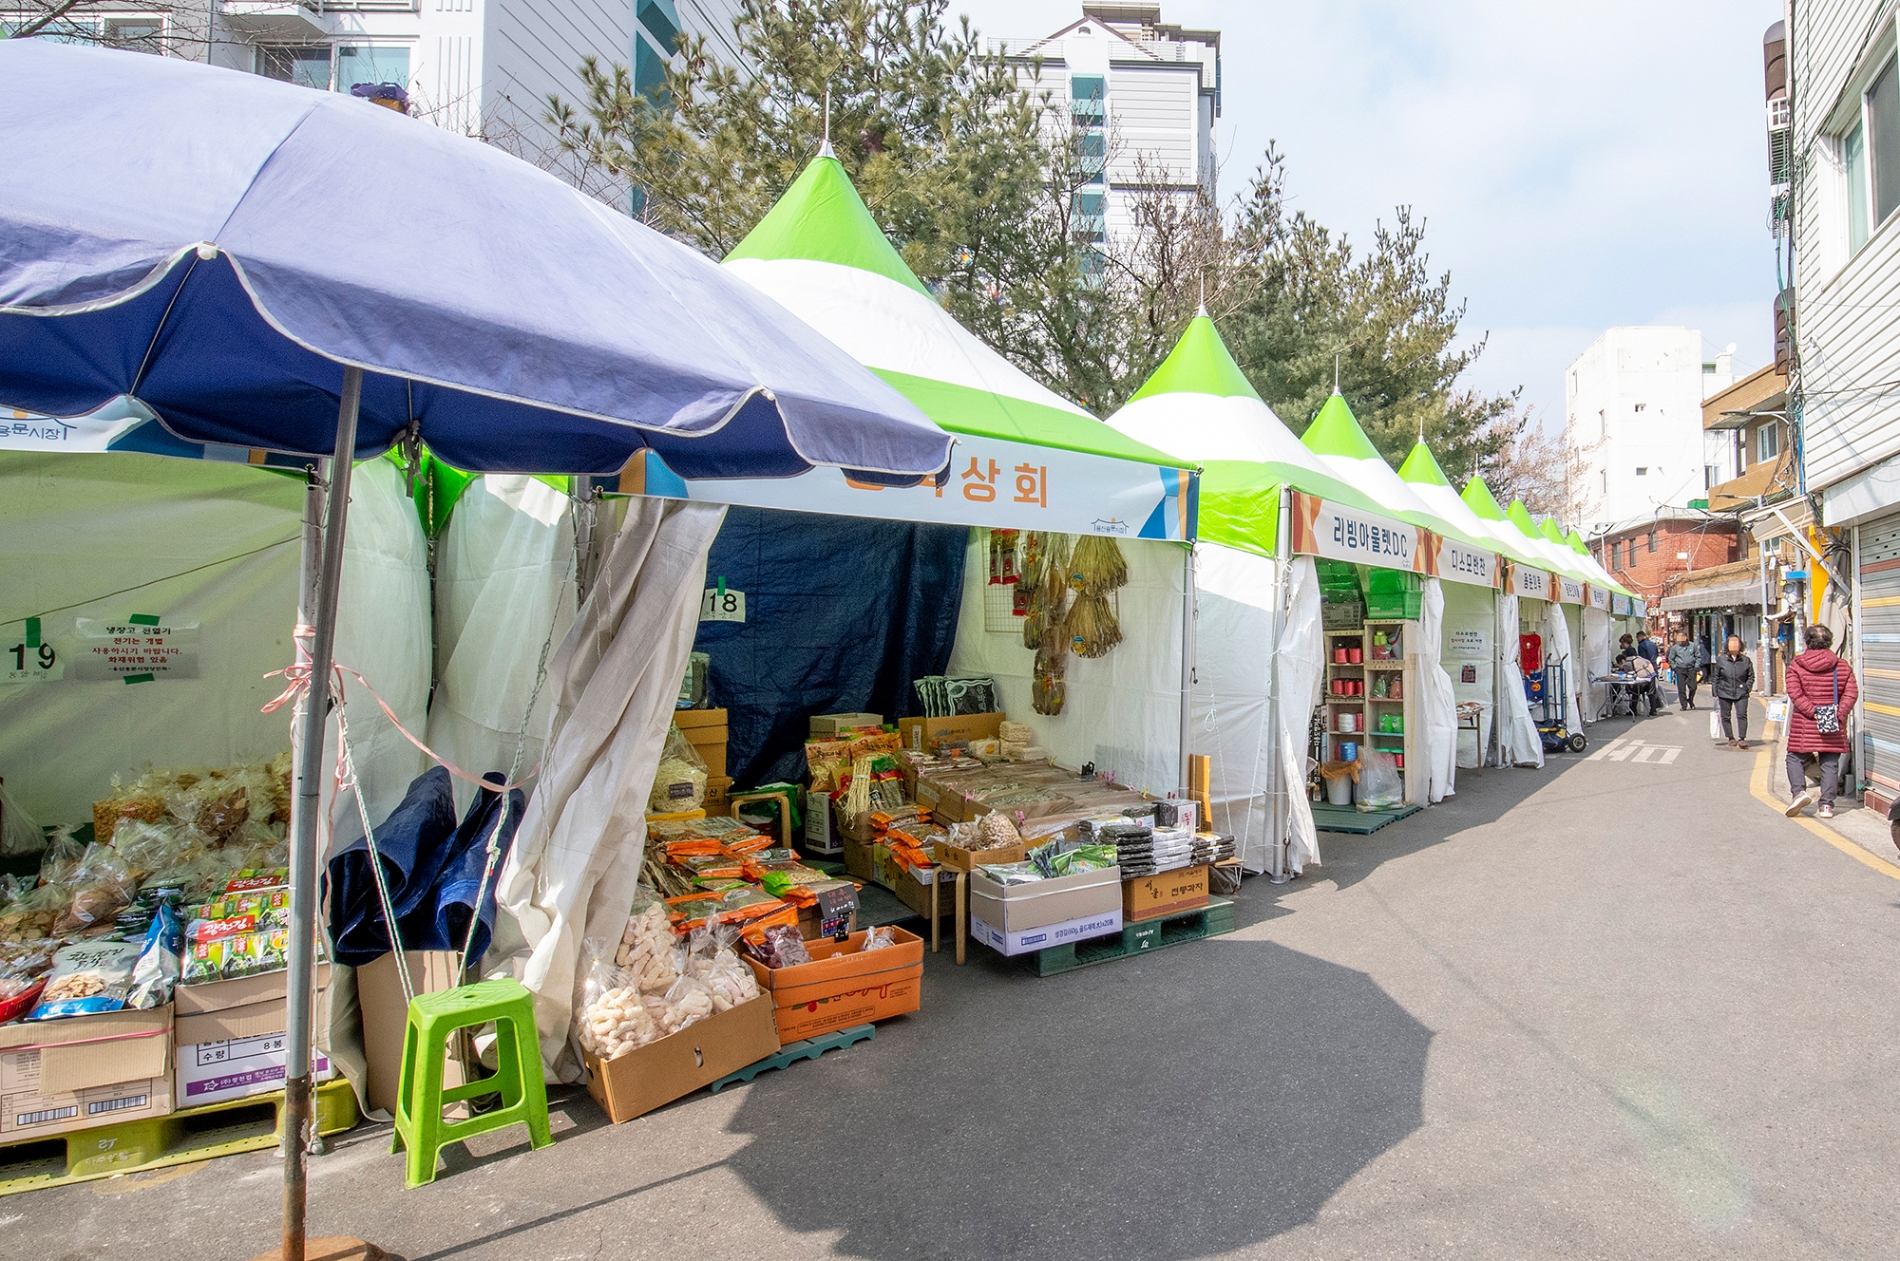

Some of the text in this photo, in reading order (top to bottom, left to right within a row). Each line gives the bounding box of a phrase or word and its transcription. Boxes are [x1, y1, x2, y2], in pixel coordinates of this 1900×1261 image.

[1333, 515, 1408, 558] 리빙아울렛DC
[709, 592, 738, 613] 18
[92, 647, 138, 655] 사용하시기
[113, 637, 140, 645] 전기는
[9, 642, 56, 671] 19
[1171, 881, 1203, 897] 전통과자
[203, 916, 248, 936] 광천김
